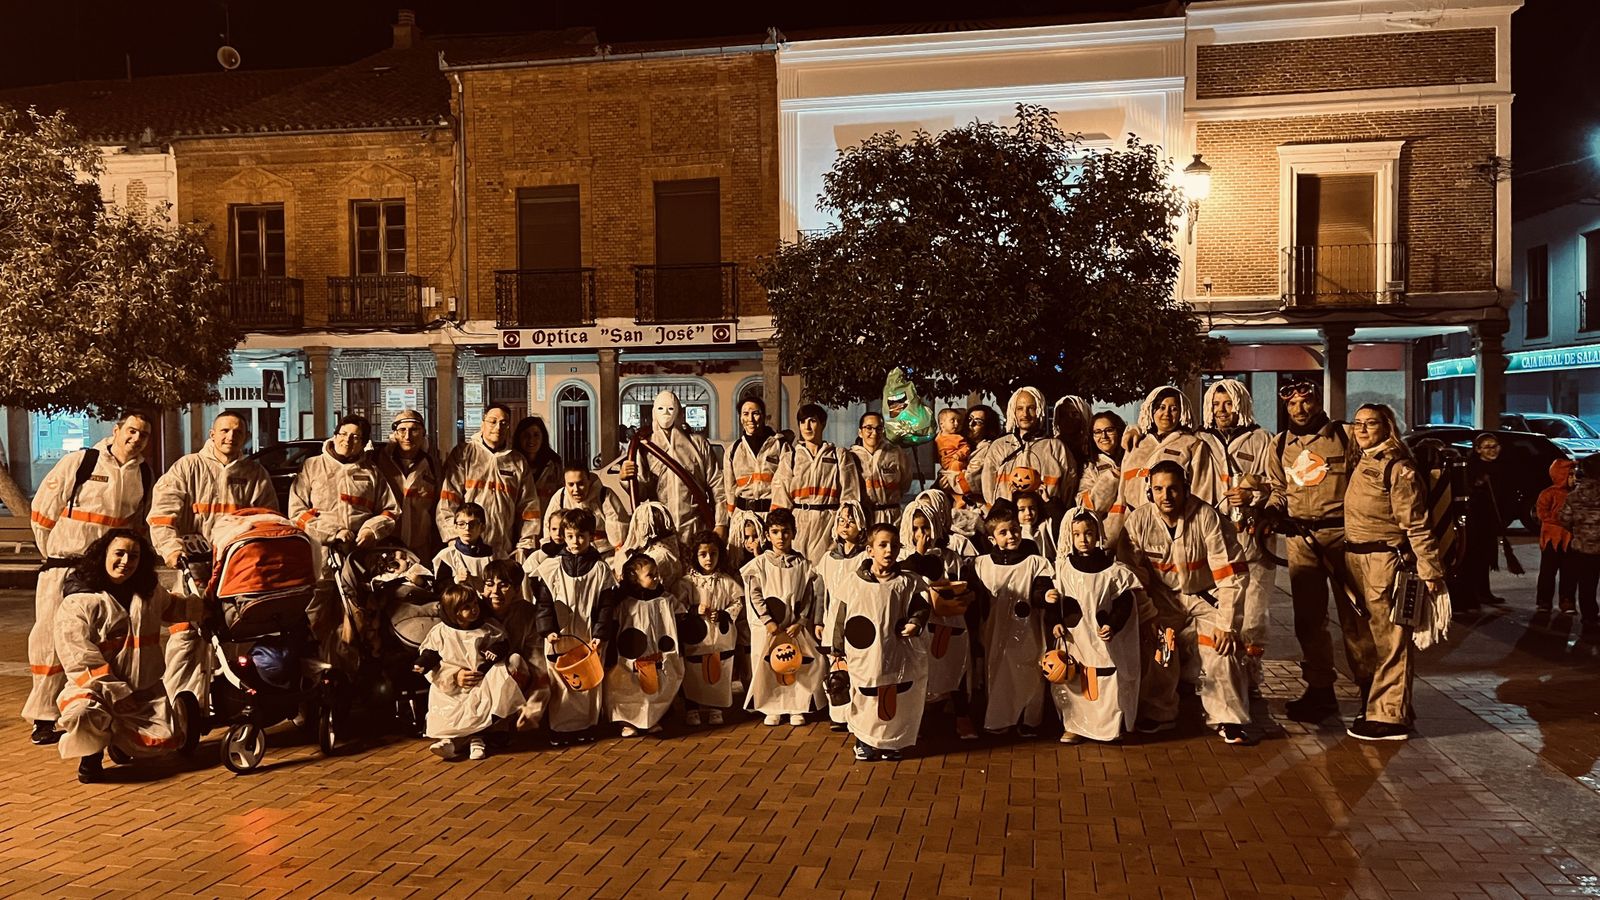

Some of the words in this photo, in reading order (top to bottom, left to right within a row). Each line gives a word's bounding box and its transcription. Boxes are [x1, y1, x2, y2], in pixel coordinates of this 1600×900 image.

[532, 329, 588, 347] Optica
[1521, 357, 1537, 368] CAJA
[1538, 354, 1563, 367] RURAL
[1564, 353, 1576, 365] DE
[618, 362, 654, 377] ptica
